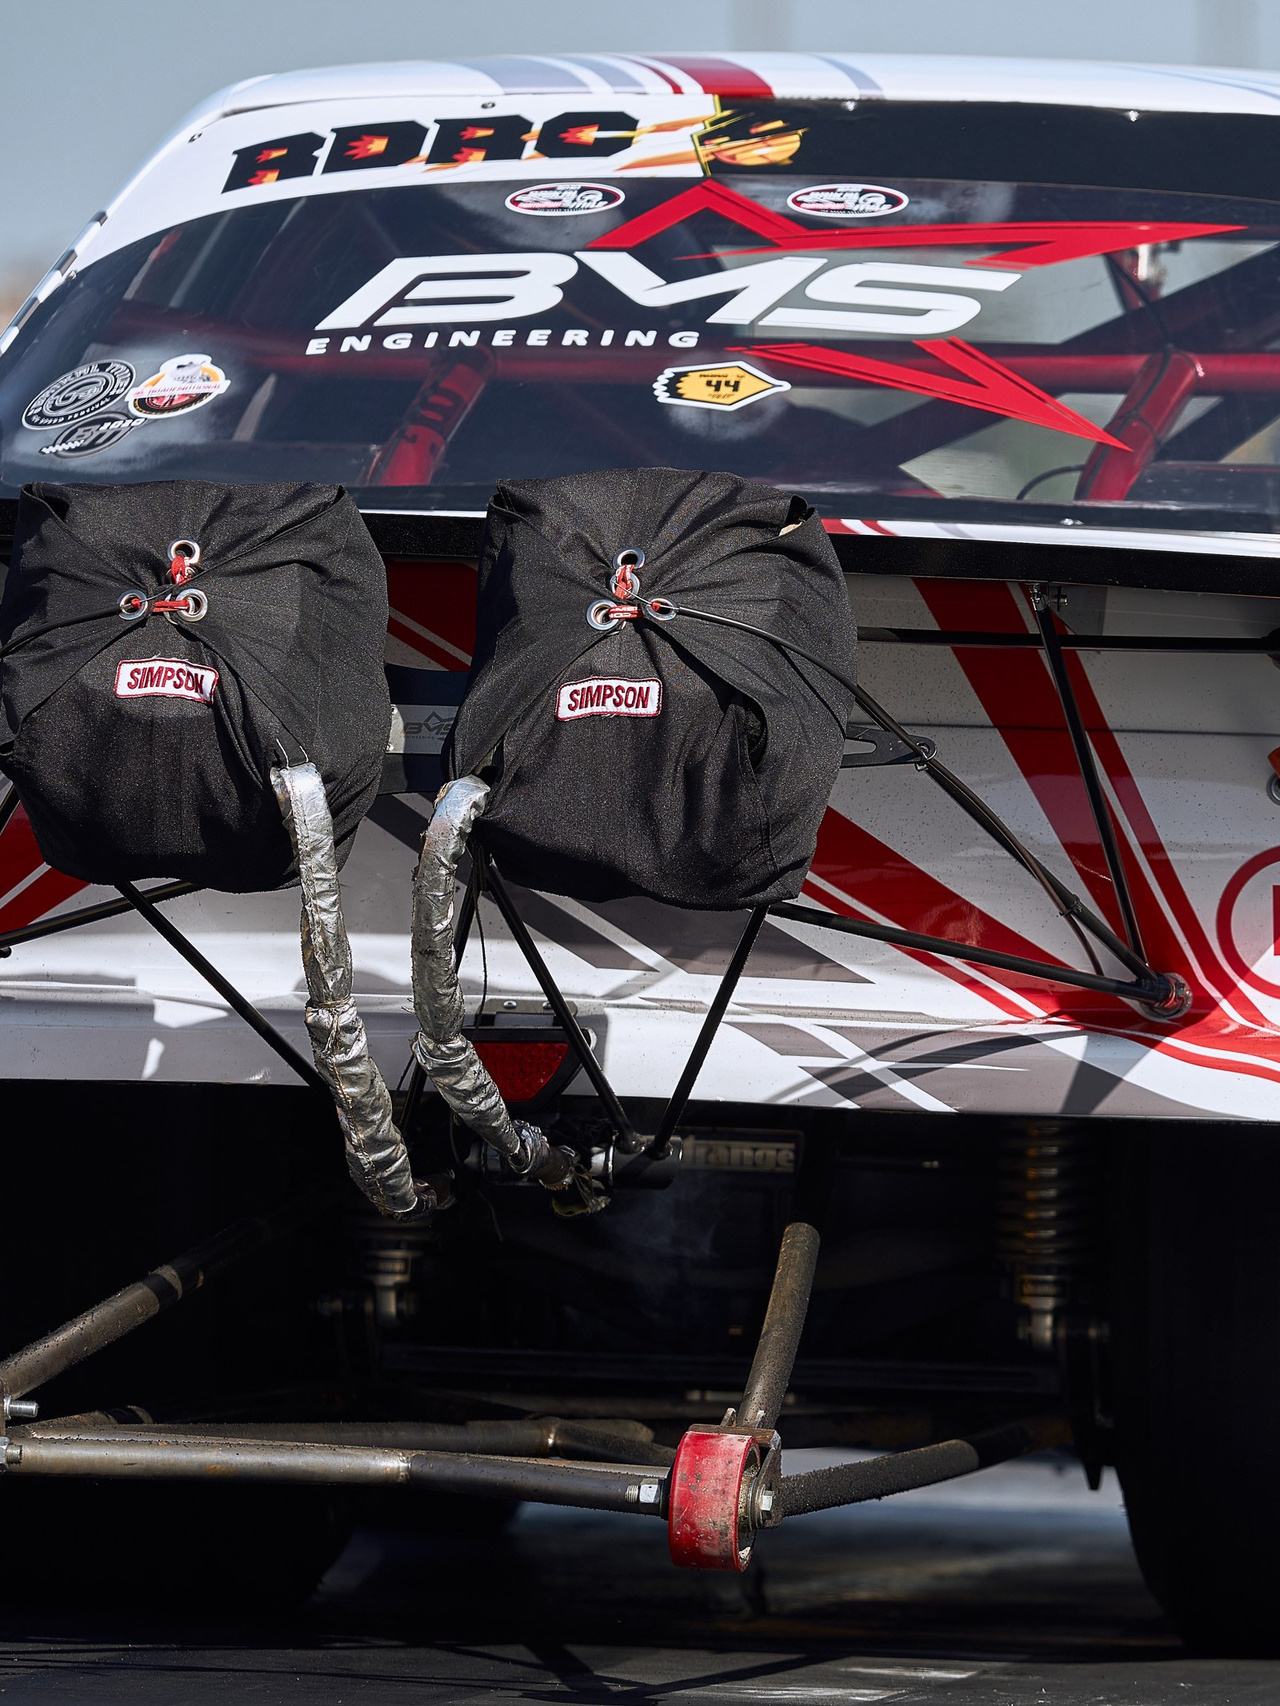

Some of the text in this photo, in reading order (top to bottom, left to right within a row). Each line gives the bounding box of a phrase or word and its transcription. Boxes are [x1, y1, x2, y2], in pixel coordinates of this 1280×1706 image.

[222, 111, 640, 194] RDRC
[314, 251, 1022, 336] BMS
[305, 329, 700, 355] ENGINEERING
[705, 380, 741, 392] 44
[127, 666, 205, 694] SIMPSON
[567, 684, 651, 712] SIMPSON
